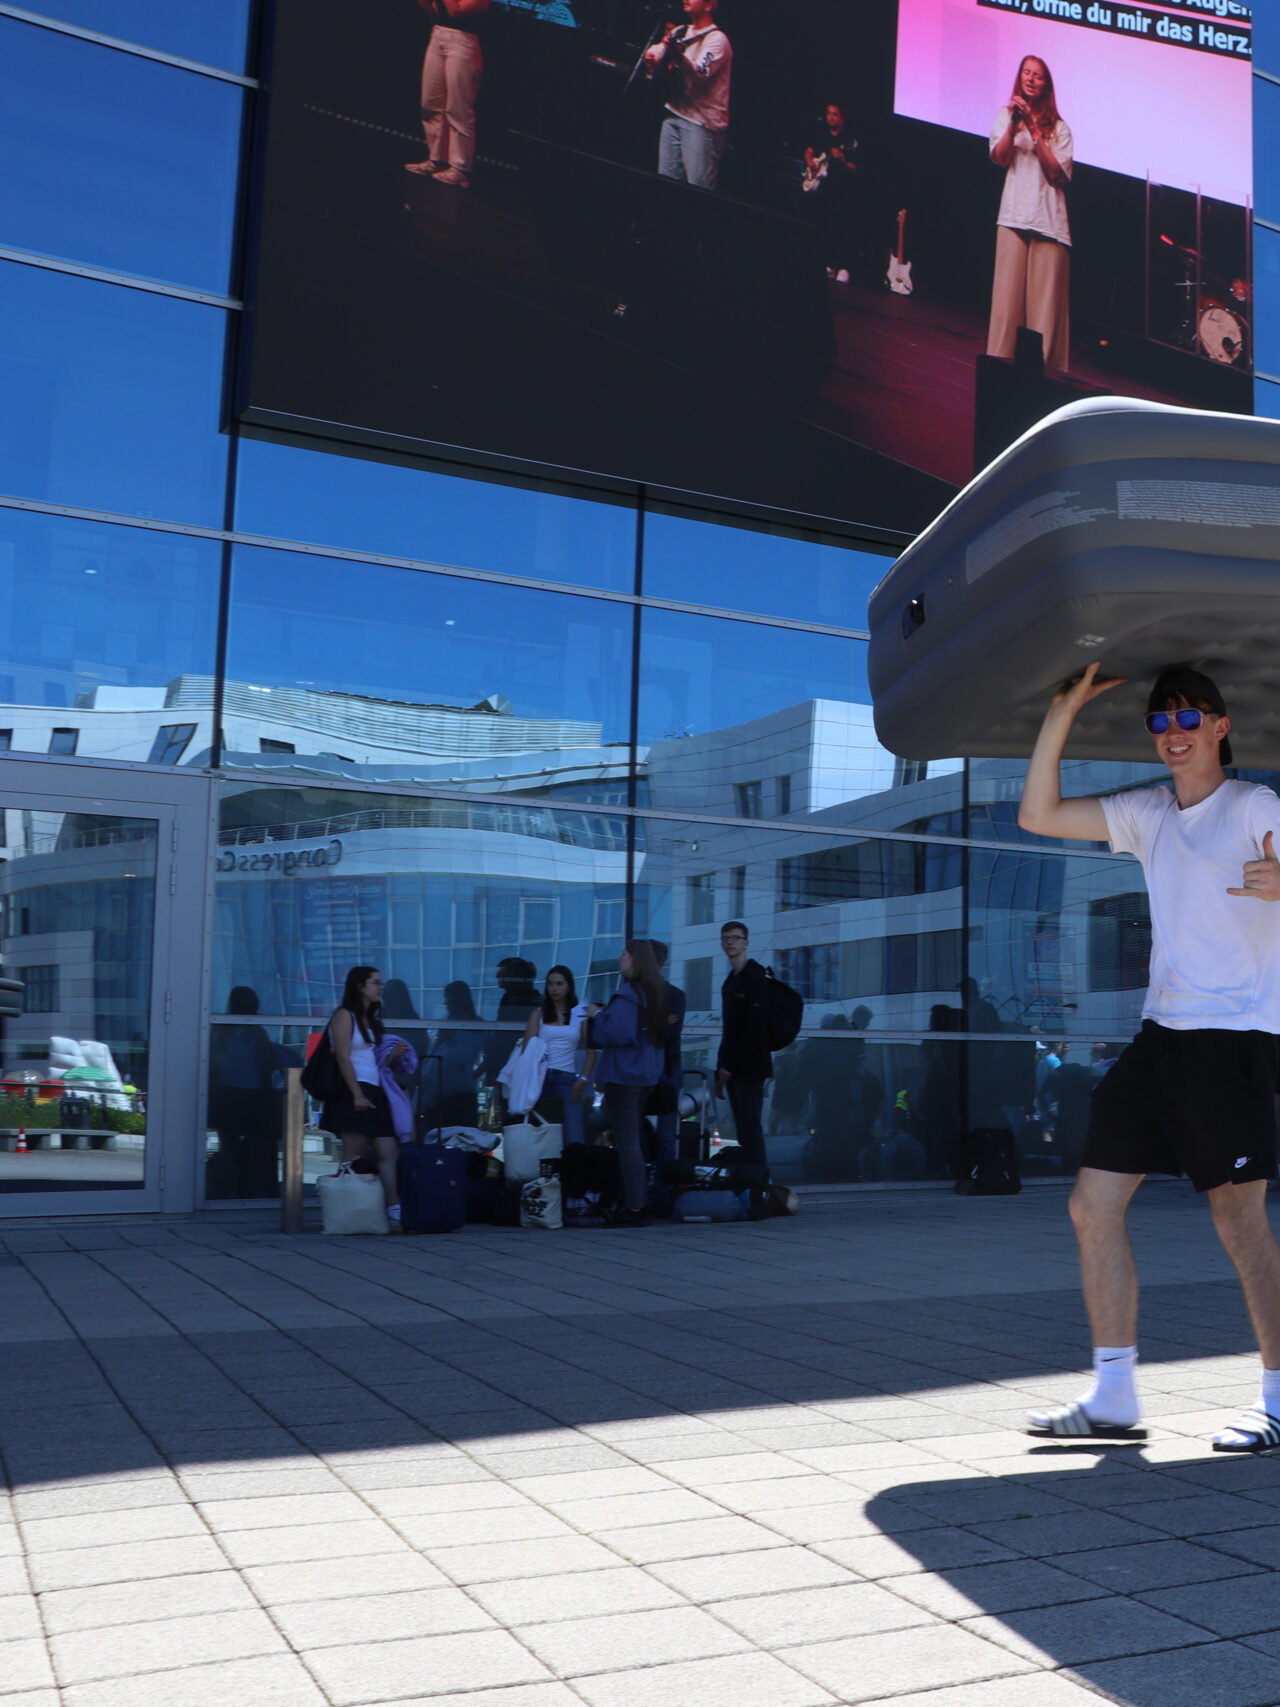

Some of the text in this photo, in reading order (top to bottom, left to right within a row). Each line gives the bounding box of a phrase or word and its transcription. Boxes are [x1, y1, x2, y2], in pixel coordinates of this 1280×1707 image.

[1087, 8, 1111, 26] du
[1117, 13, 1152, 33] mir
[1156, 17, 1193, 42] das
[1199, 24, 1252, 54] Herz.
